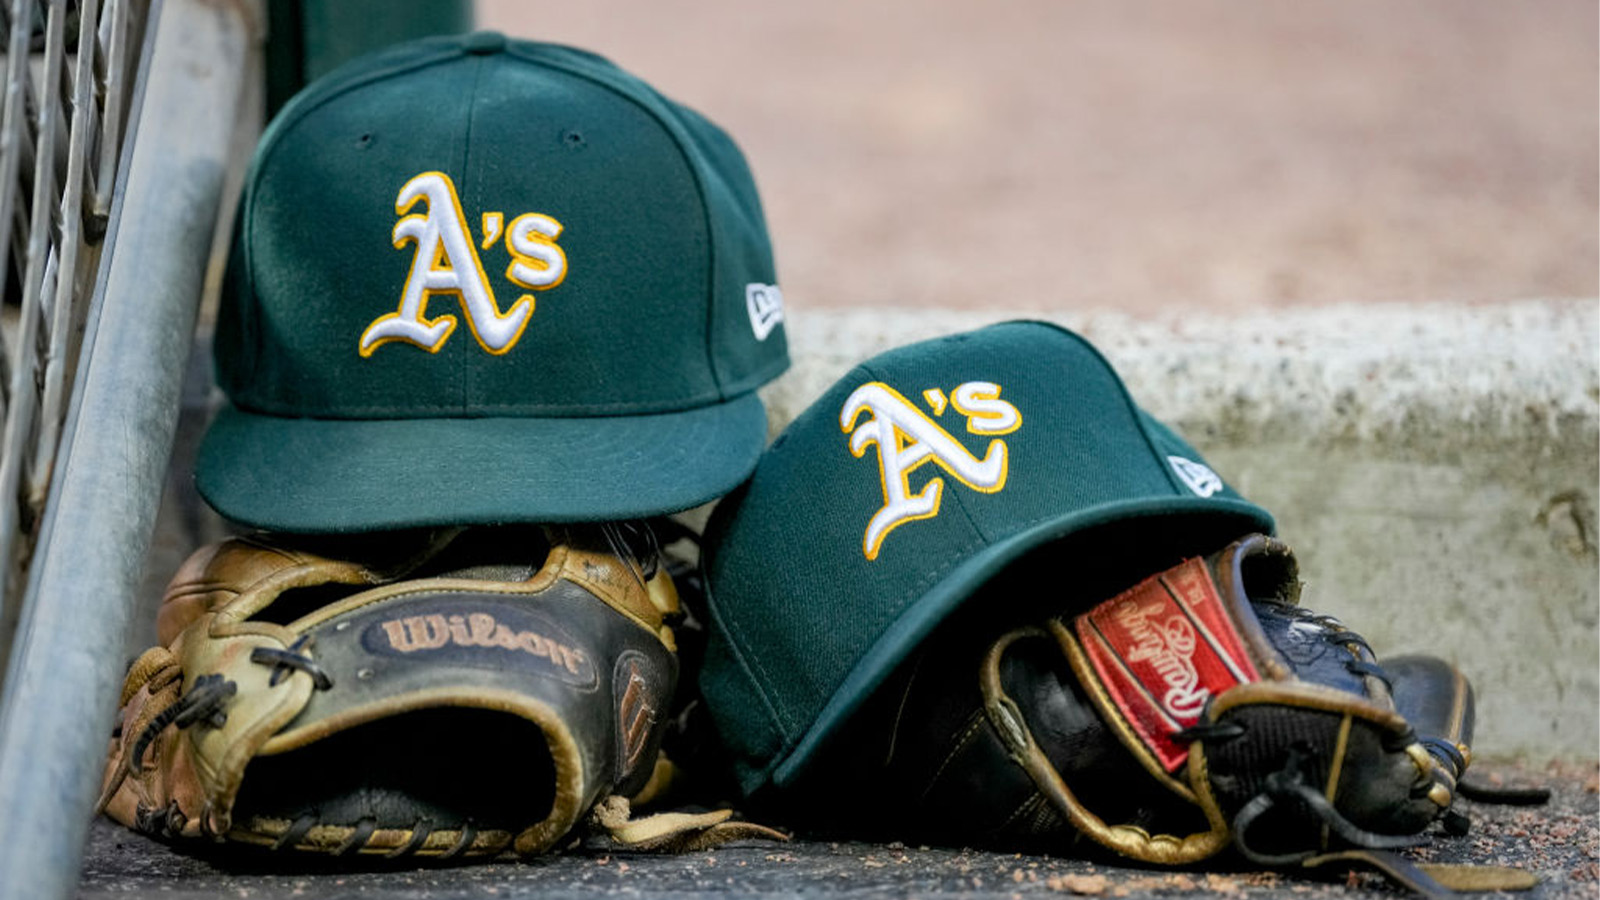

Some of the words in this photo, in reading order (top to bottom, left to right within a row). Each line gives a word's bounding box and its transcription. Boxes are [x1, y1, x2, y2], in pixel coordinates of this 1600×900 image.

[360, 171, 568, 358] A's
[840, 381, 1023, 561] A's
[382, 613, 584, 675] Wilson
[1117, 601, 1210, 718] Rawlings
